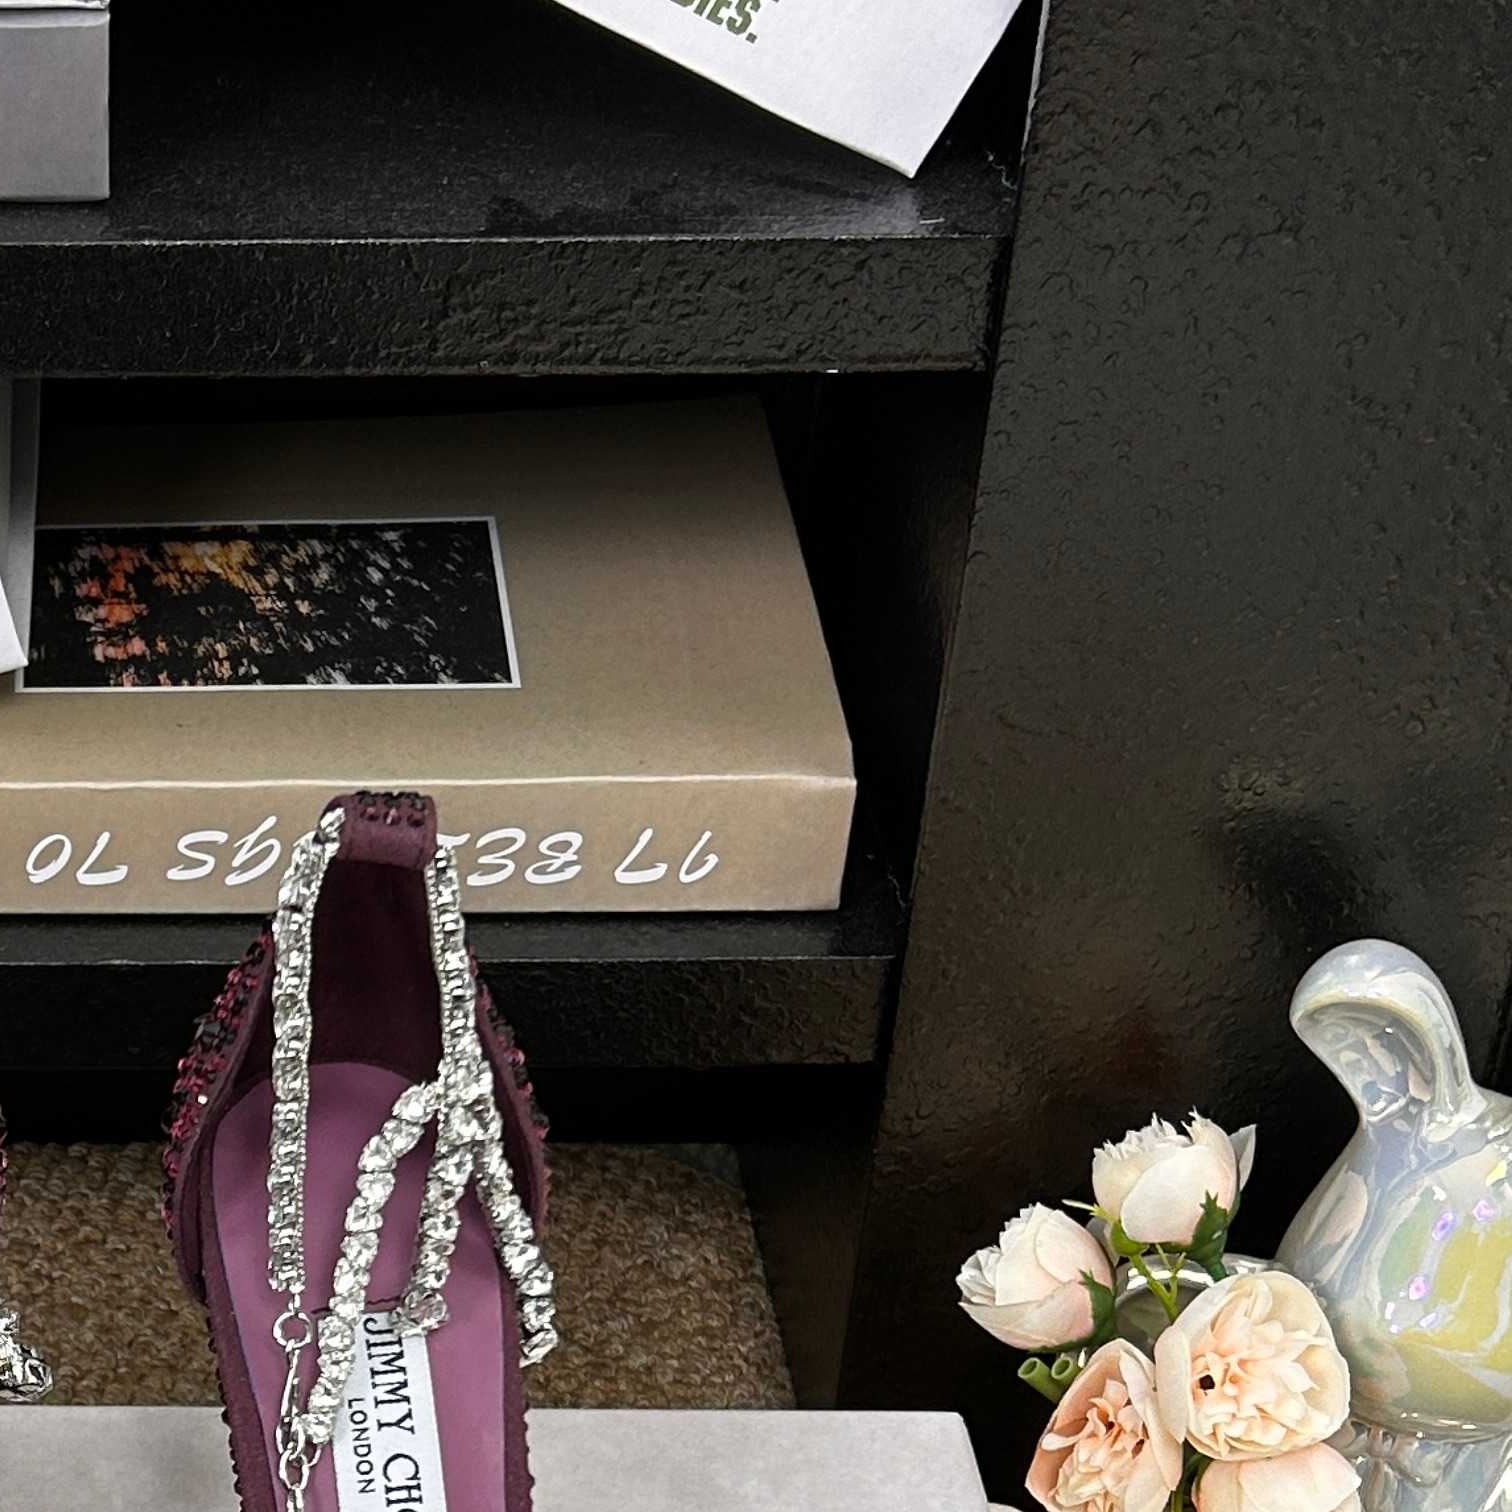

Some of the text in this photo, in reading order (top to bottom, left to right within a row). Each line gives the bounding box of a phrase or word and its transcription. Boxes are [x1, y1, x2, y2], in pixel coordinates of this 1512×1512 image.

[25, 830, 129, 886] TO
[613, 827, 719, 885] IT
[363, 1317, 416, 1435] JIMMY
[348, 1398, 377, 1495] LONDON
